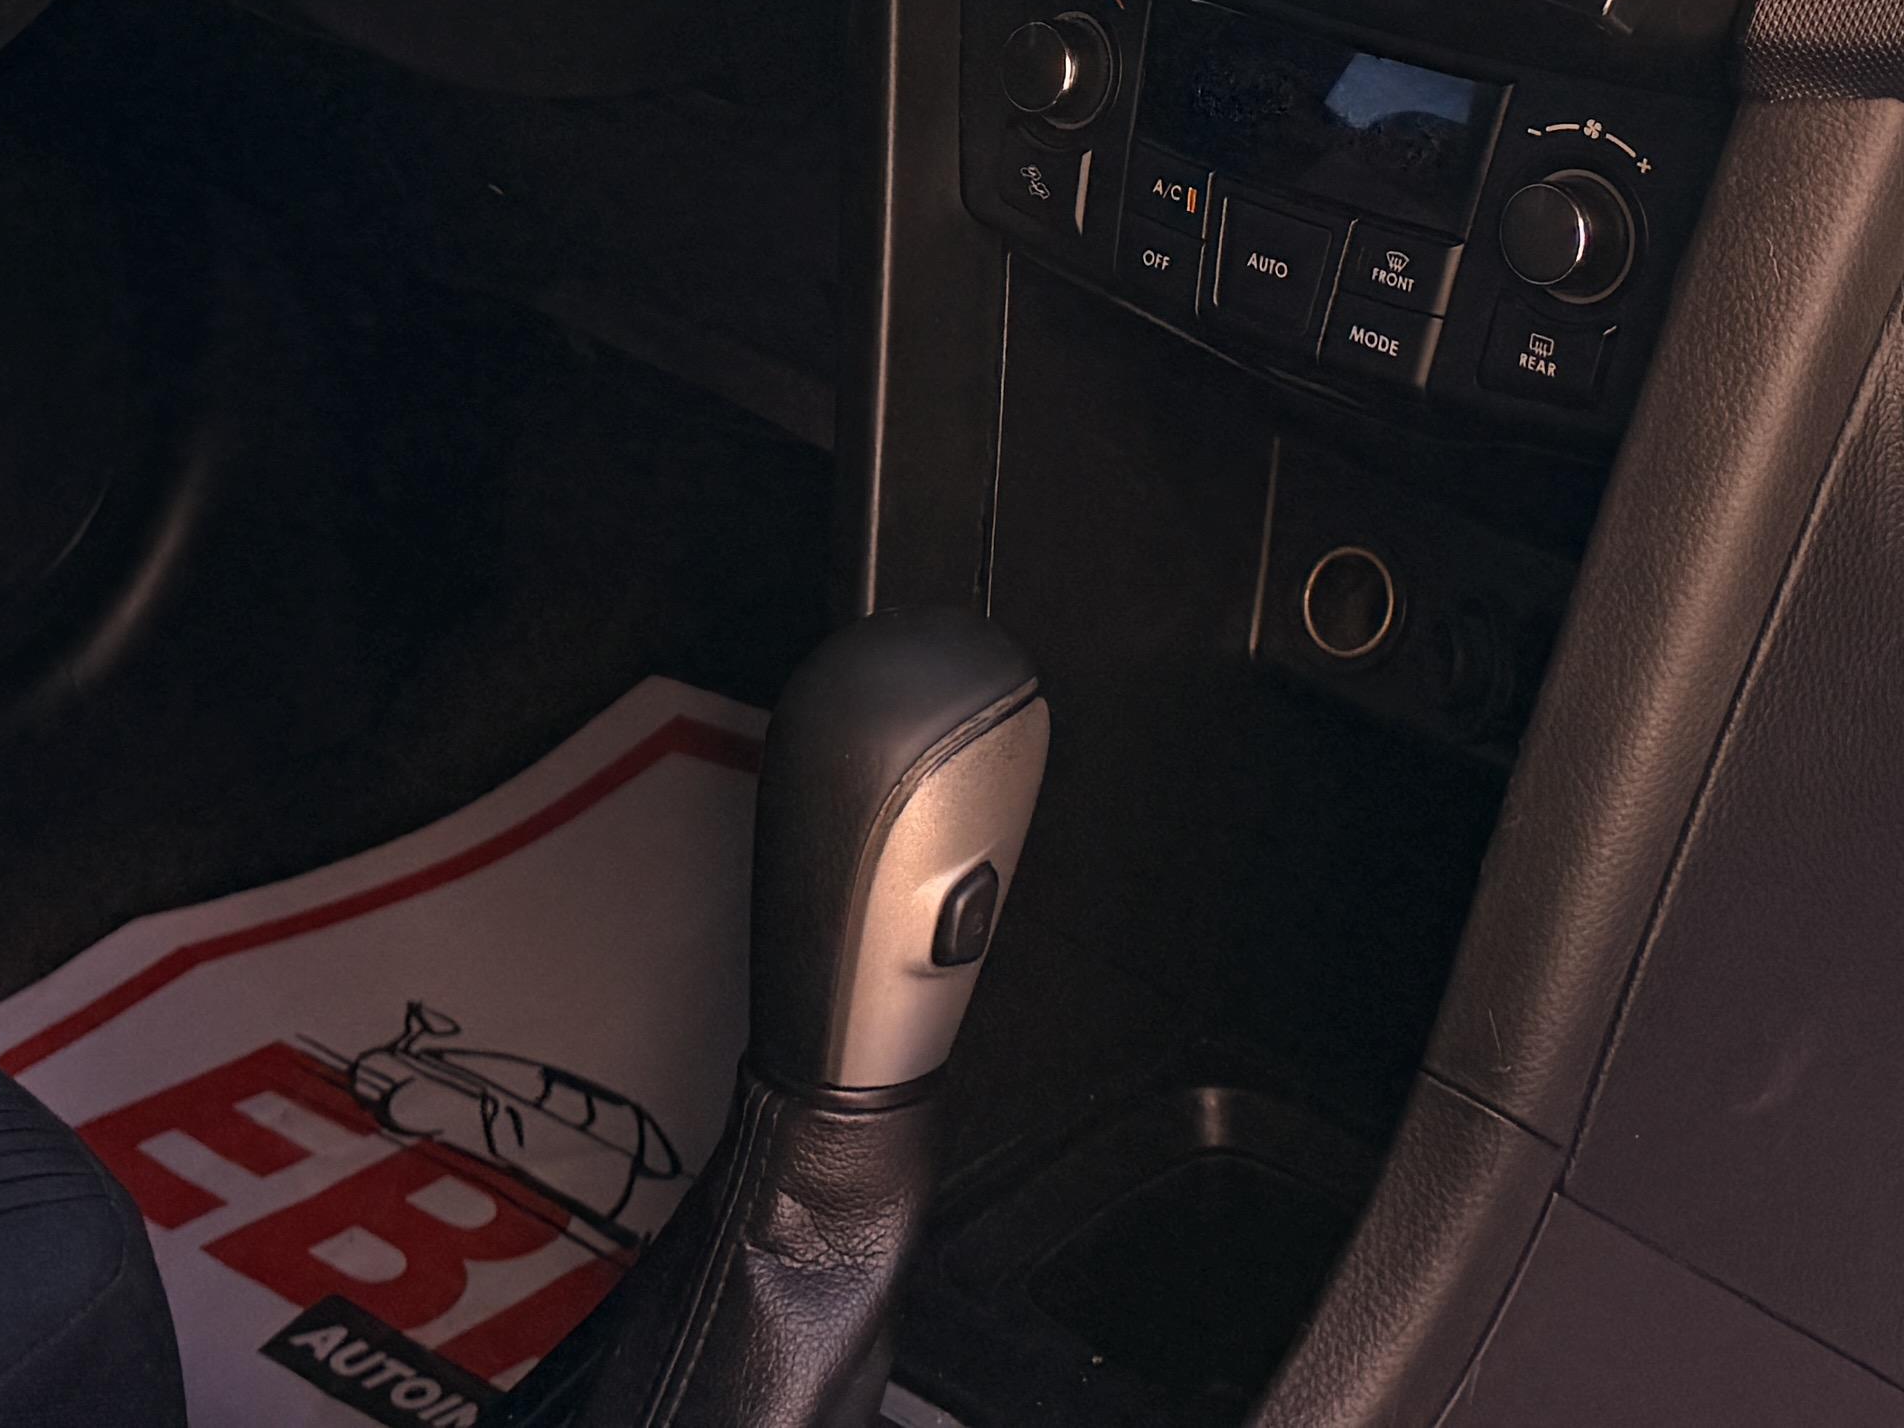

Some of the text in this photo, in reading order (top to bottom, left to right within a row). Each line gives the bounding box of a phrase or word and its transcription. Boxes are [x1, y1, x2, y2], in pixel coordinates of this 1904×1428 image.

[1151, 177, 1183, 202] A/C
[1142, 249, 1171, 271] OFF
[1246, 251, 1289, 279] AUTO
[1371, 265, 1415, 294] FRONT
[1348, 324, 1400, 357] MODE
[1518, 352, 1557, 379] REAR
